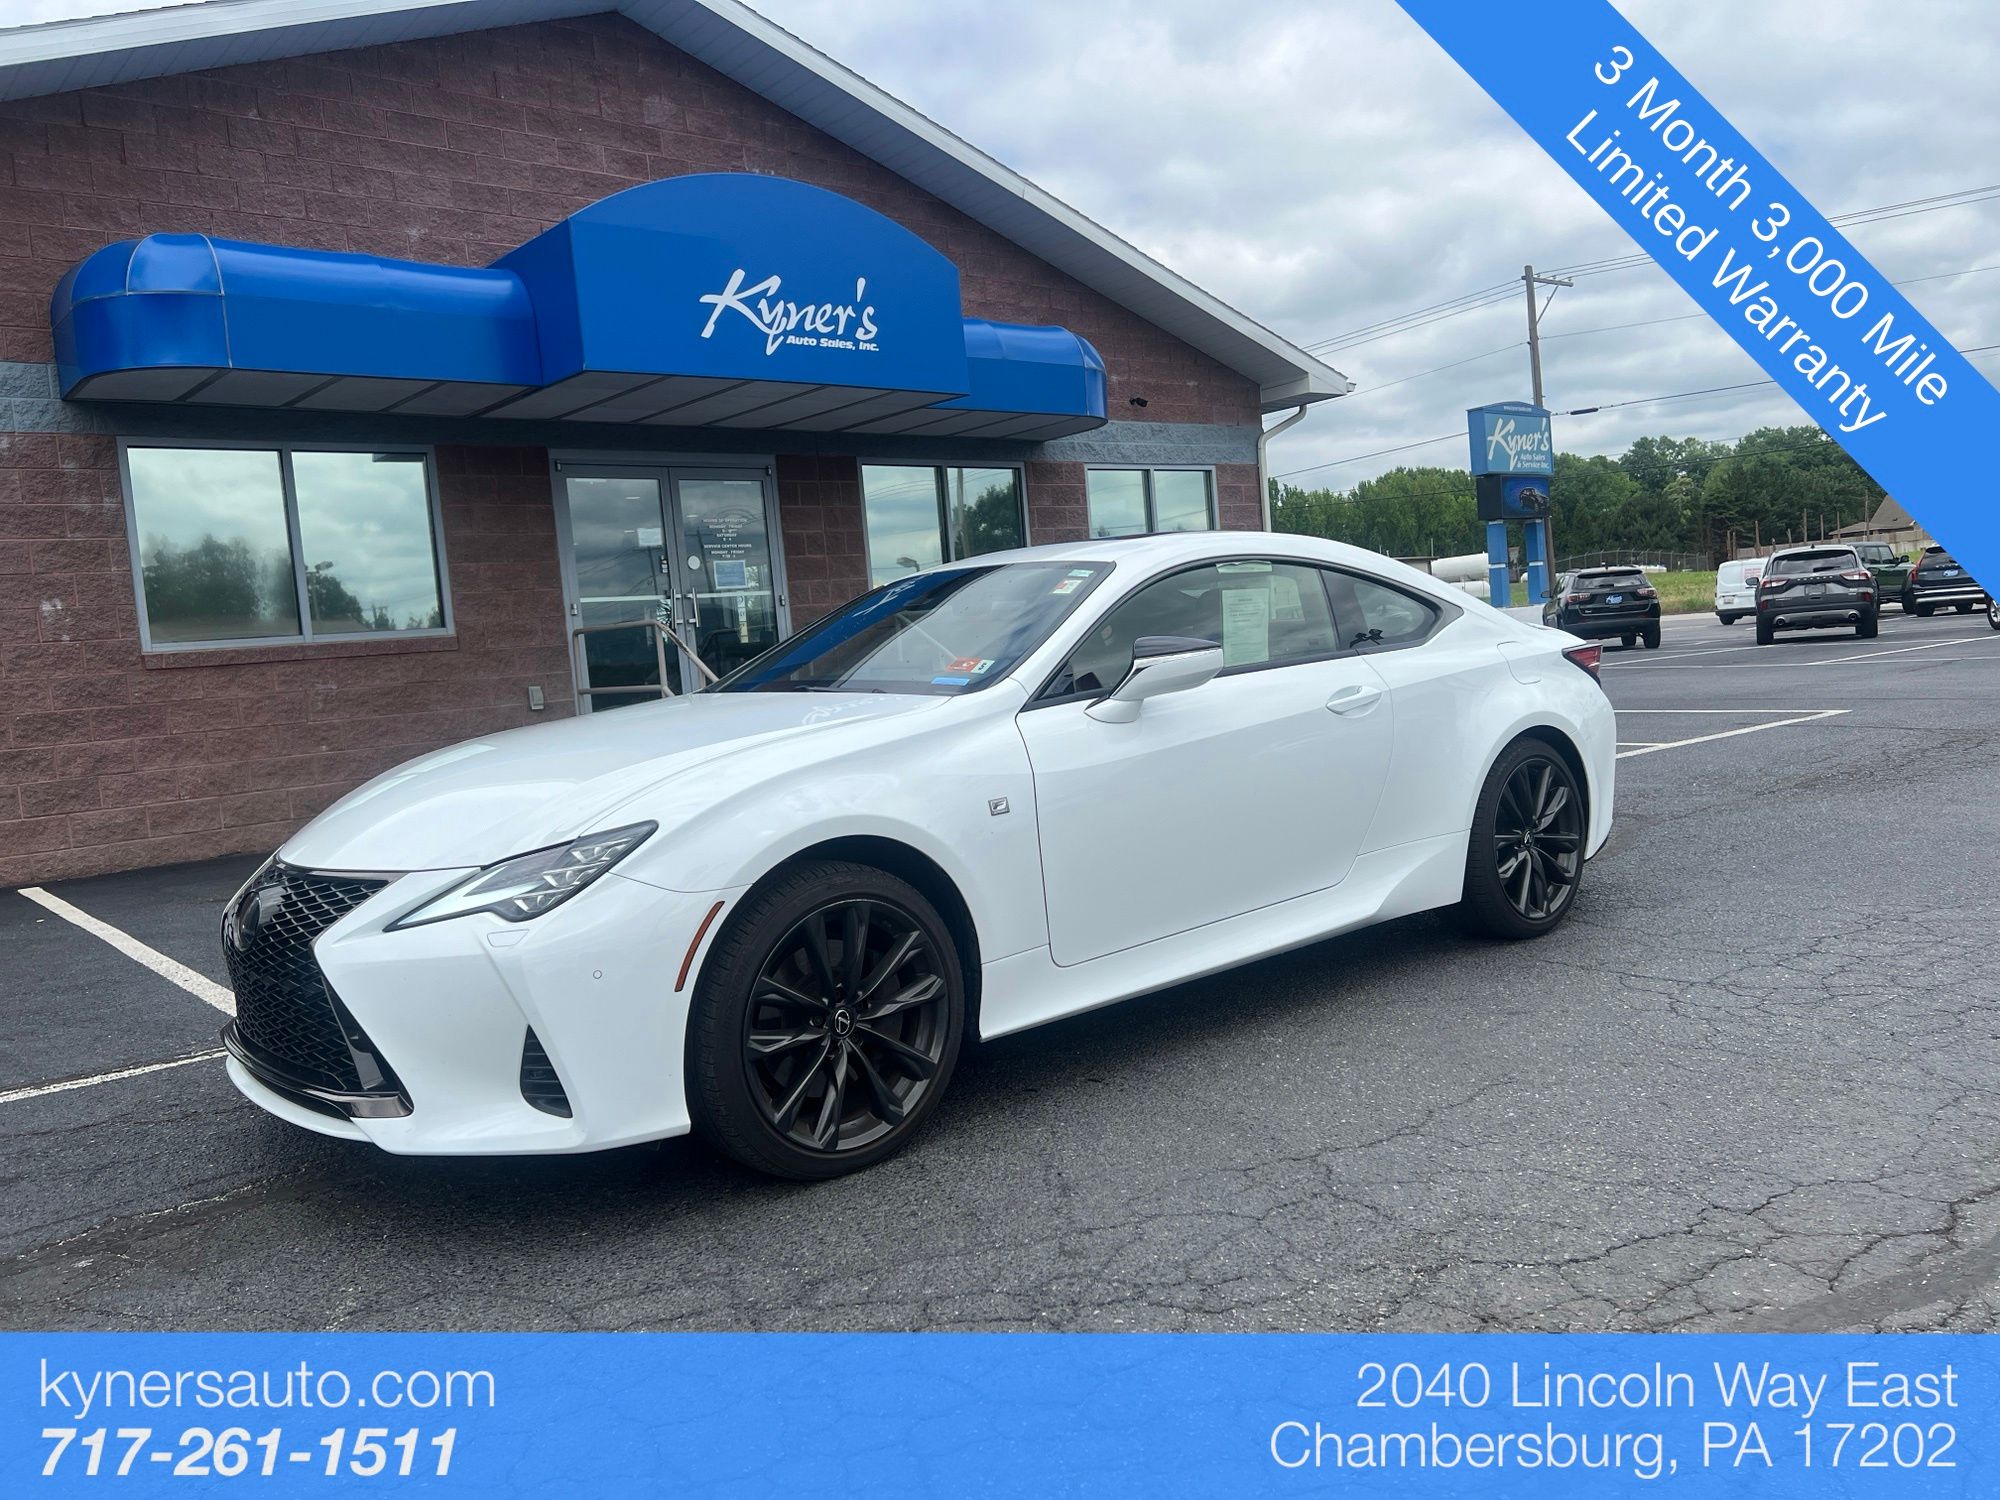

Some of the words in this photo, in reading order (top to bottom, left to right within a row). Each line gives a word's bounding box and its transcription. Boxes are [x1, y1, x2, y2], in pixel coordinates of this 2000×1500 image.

[699, 268, 878, 356] Kyner's
[786, 335, 817, 346] Auto
[820, 338, 855, 351] Sales,
[859, 341, 879, 352] Inc.
[1487, 417, 1549, 472] Kyner's
